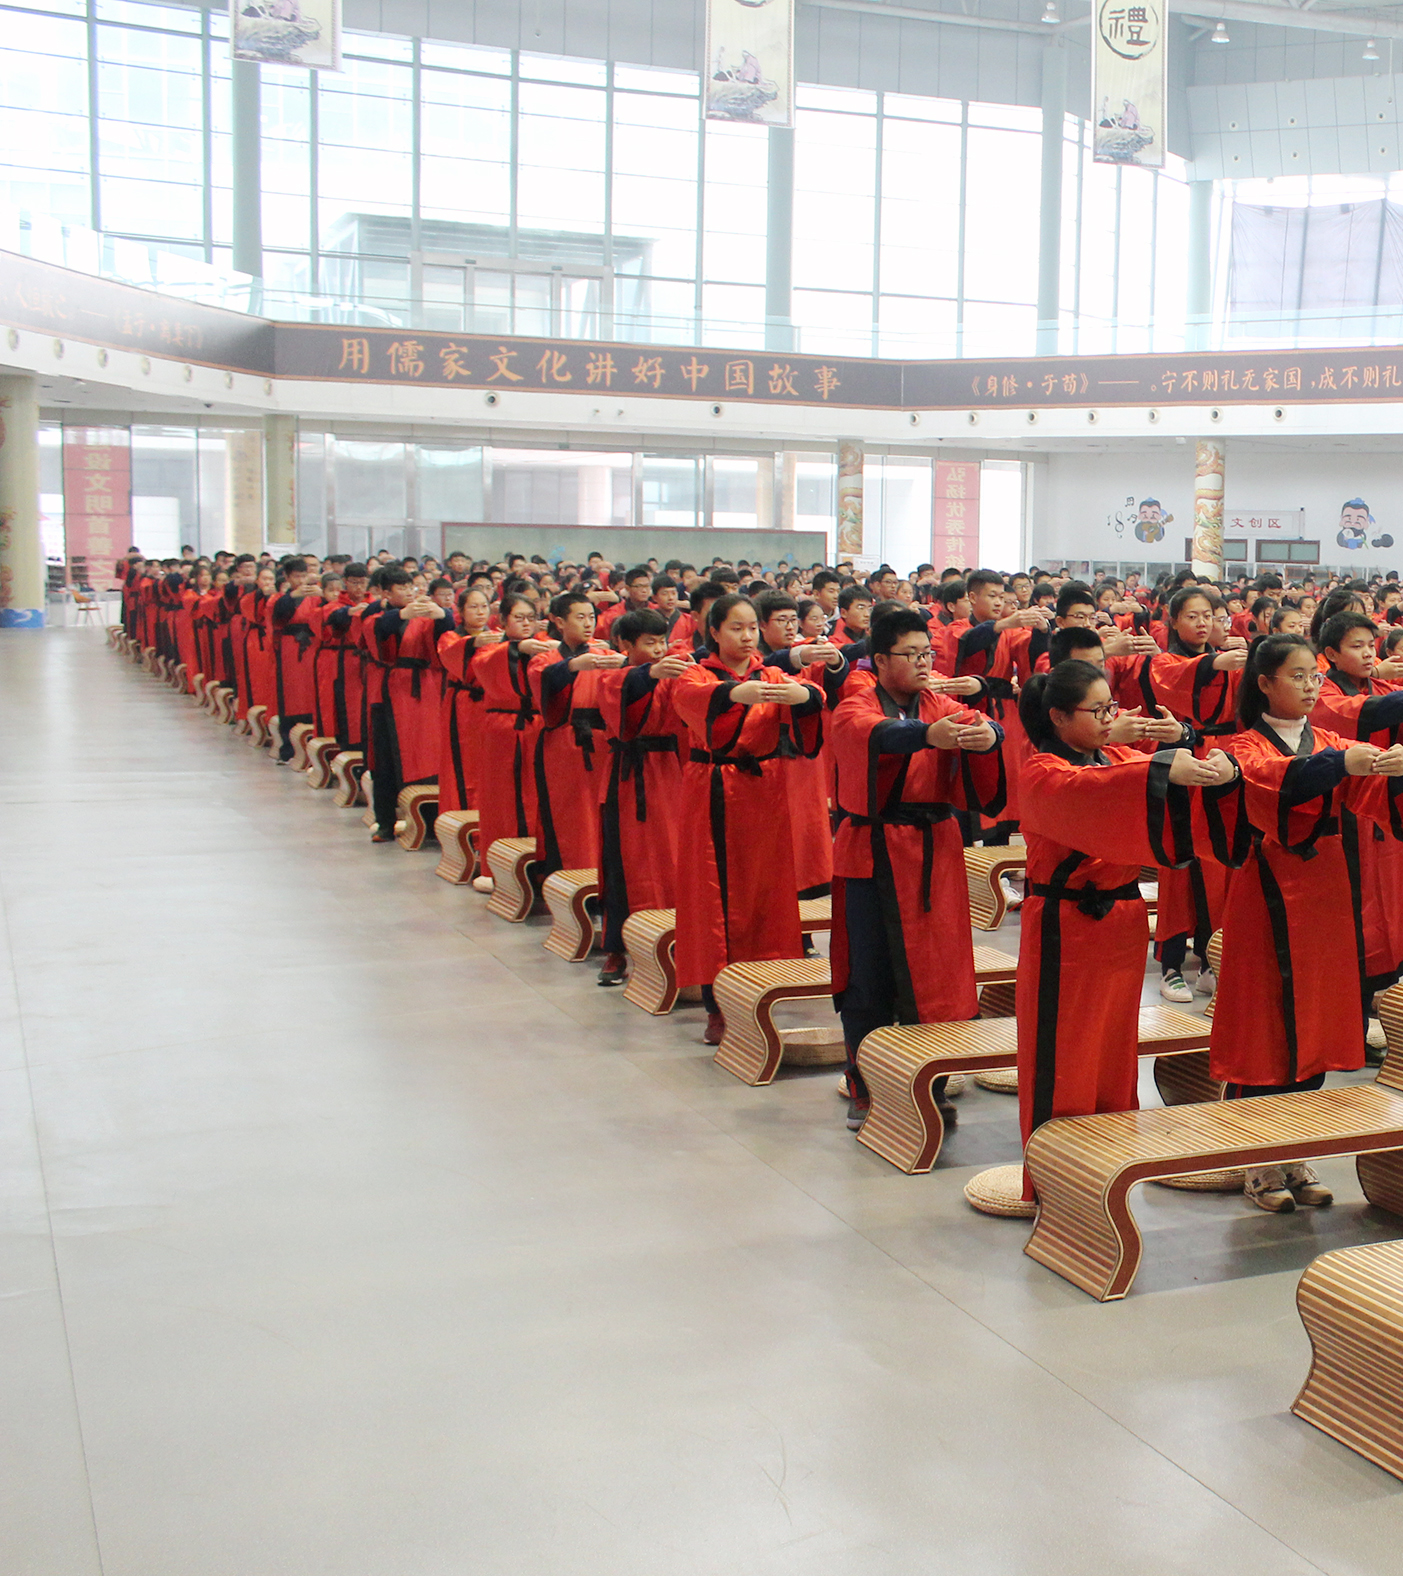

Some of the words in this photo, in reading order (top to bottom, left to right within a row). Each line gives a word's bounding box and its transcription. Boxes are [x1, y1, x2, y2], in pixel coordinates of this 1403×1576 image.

[1107, 6, 1152, 46] 禮
[338, 337, 841, 400] 用儒家文化讲好中国故事
[1223, 517, 1282, 529] 文创区
